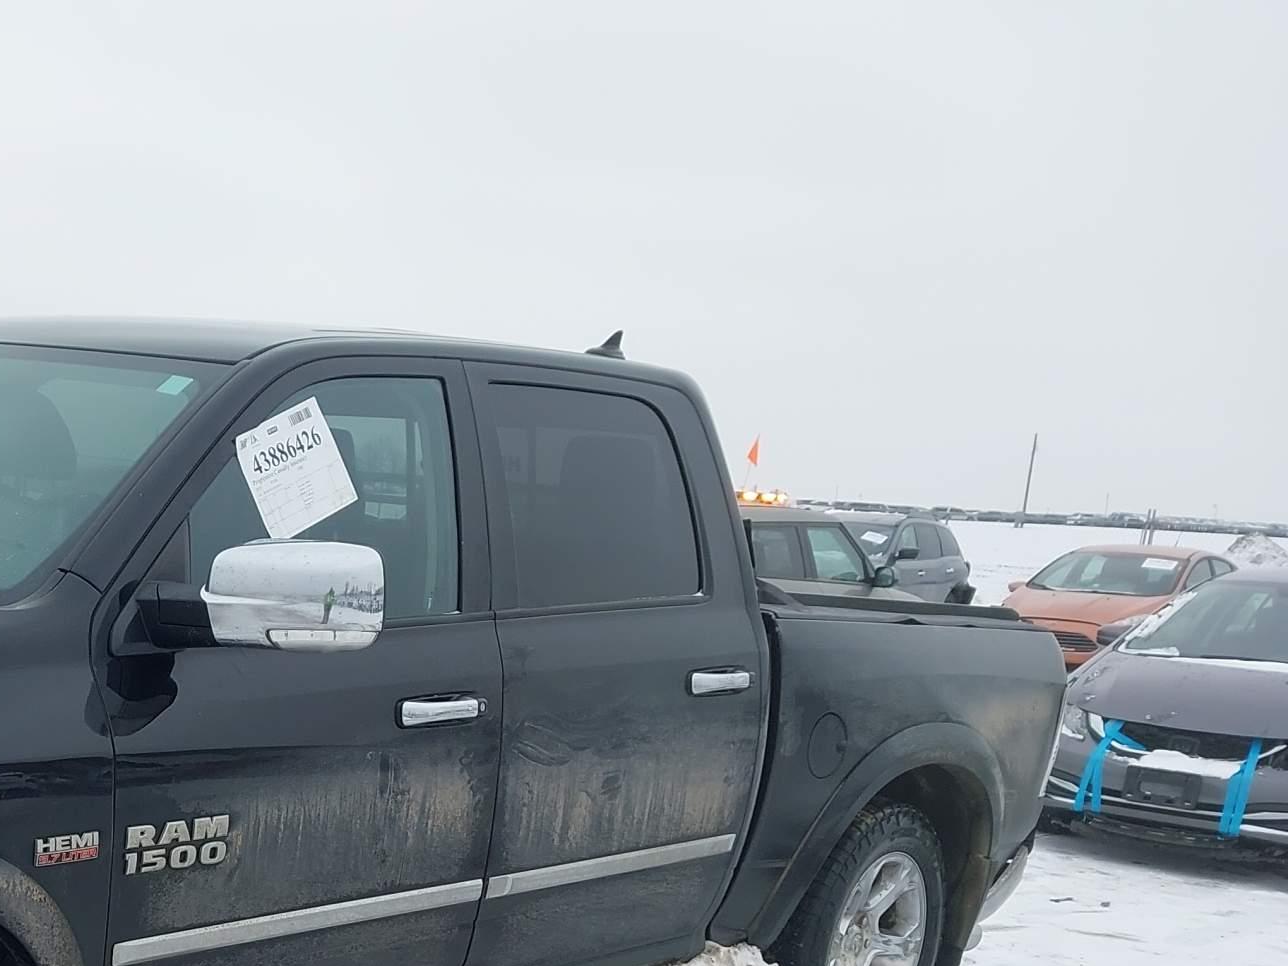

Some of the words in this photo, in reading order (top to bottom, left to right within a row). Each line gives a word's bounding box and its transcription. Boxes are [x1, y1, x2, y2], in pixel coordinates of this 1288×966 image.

[253, 425, 322, 474] 43886426
[36, 831, 99, 853] HEMI
[126, 814, 230, 850] RAM
[39, 853, 60, 865] 5.7
[62, 848, 97, 862] LITER
[125, 840, 227, 876] 1500
